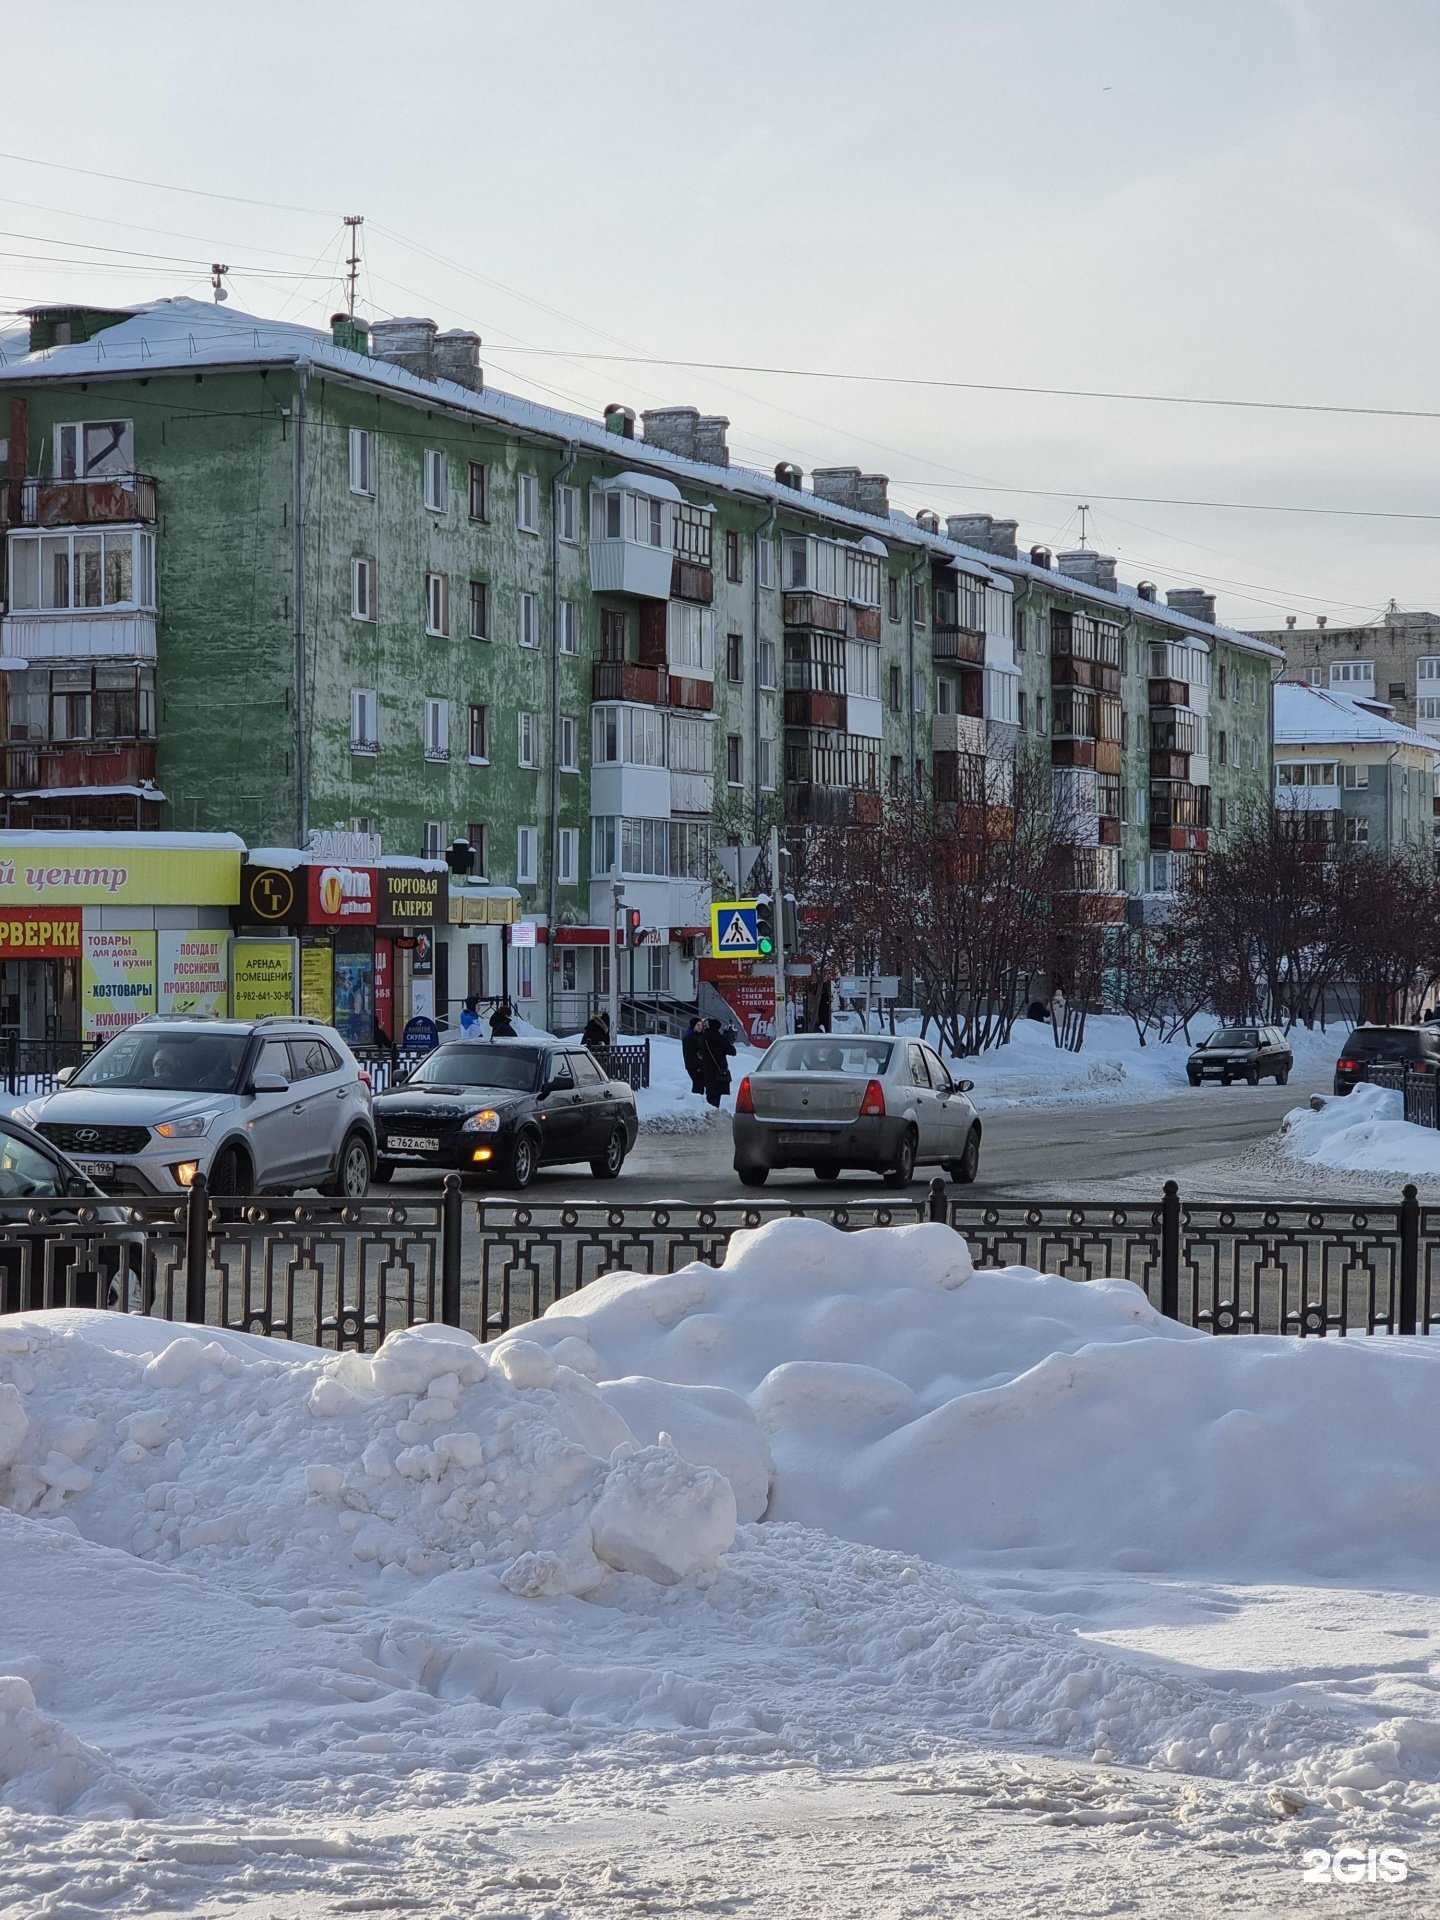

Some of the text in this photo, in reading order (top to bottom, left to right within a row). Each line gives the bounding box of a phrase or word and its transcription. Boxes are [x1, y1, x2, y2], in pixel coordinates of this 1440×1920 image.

[25, 867, 128, 893] центр
[388, 877, 438, 895] ТОРГОВАЯ
[392, 900, 433, 917] ГАЛЕРЕЯ
[88, 935, 132, 946] ТОВАРЫ
[93, 949, 138, 958] для дома
[180, 943, 208, 956] ПОСУДА
[113, 959, 153, 969] и кухни
[173, 961, 220, 975] РОССИЙСКИХ
[246, 960, 281, 970] АРЕНДА
[235, 971, 293, 983] ПОМЕЩЕНИЯ
[406, 1033, 431, 1041] СКУПКА
